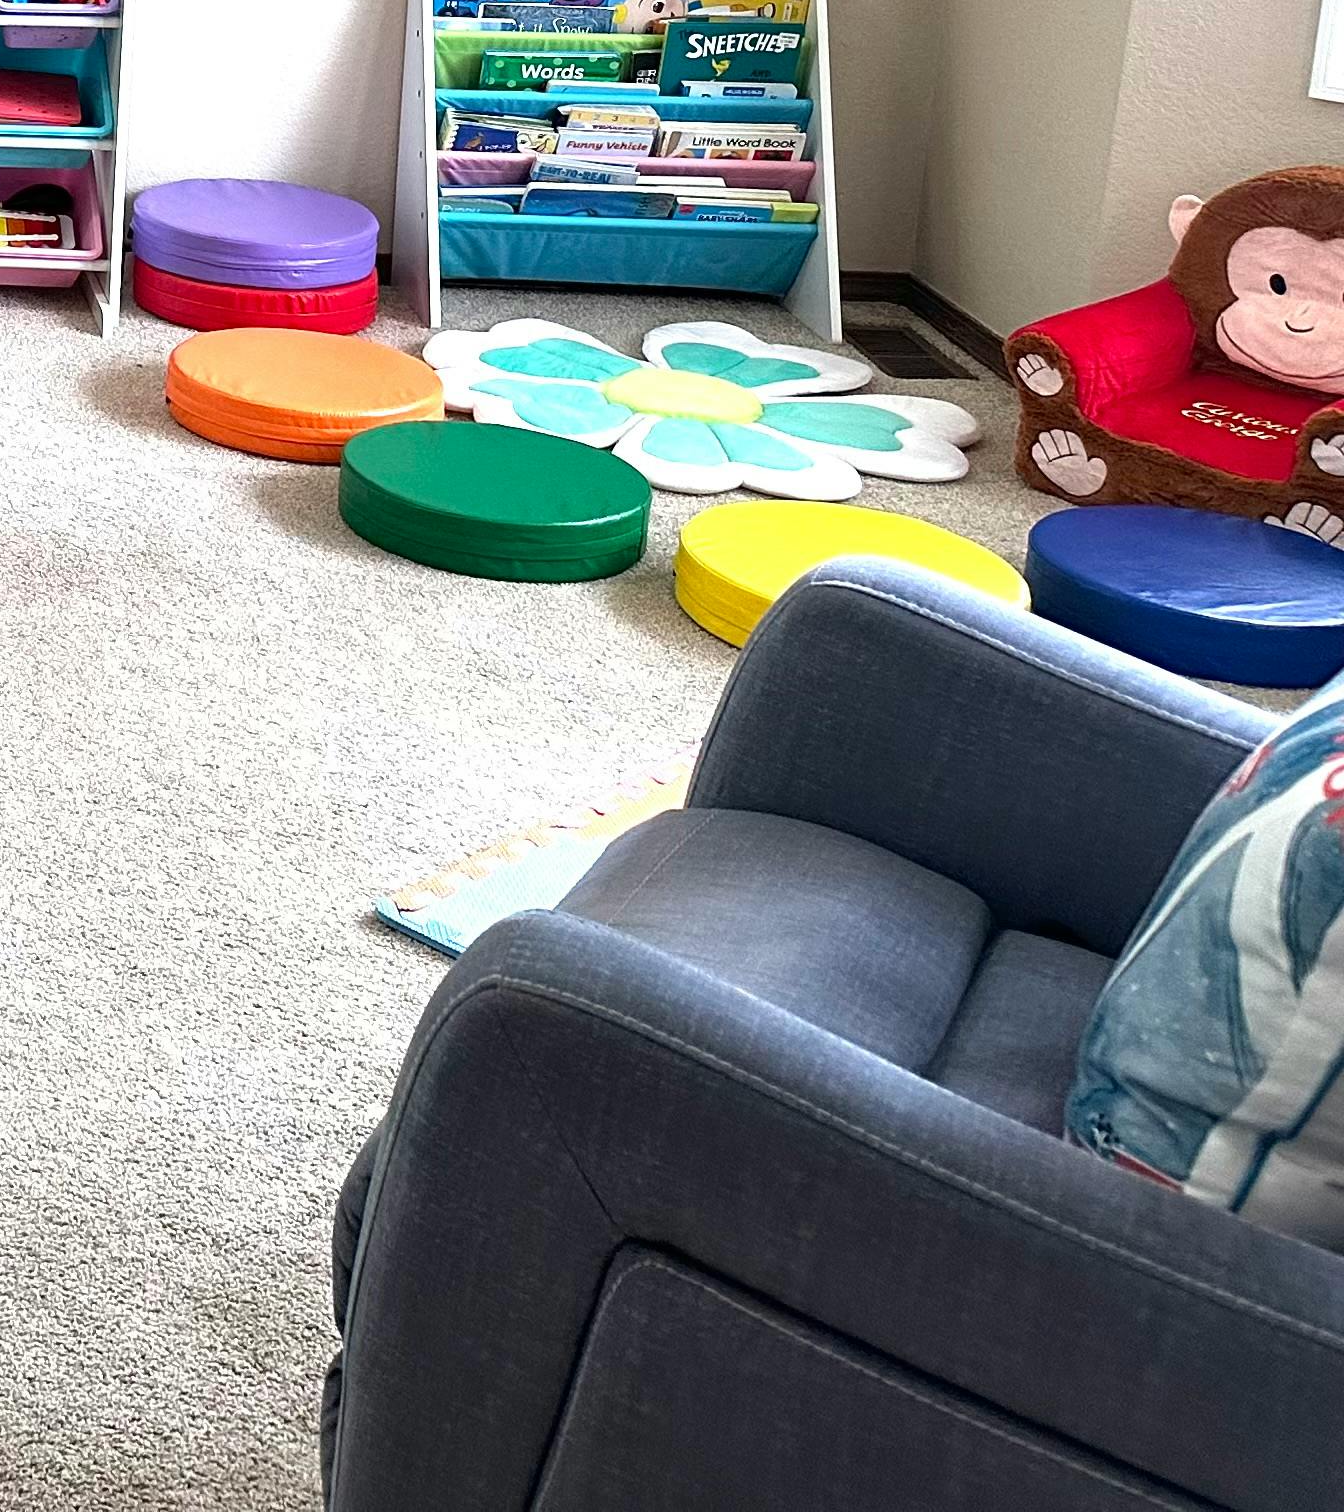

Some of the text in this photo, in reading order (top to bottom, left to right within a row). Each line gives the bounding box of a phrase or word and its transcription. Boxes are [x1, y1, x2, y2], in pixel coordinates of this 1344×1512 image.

[685, 32, 785, 59] SNEETCHES
[521, 64, 584, 80] Words
[566, 140, 648, 150] Funny Vehicle
[692, 137, 796, 148] Little Word Book
[1181, 409, 1278, 441] George
[1192, 401, 1299, 435] Curious
